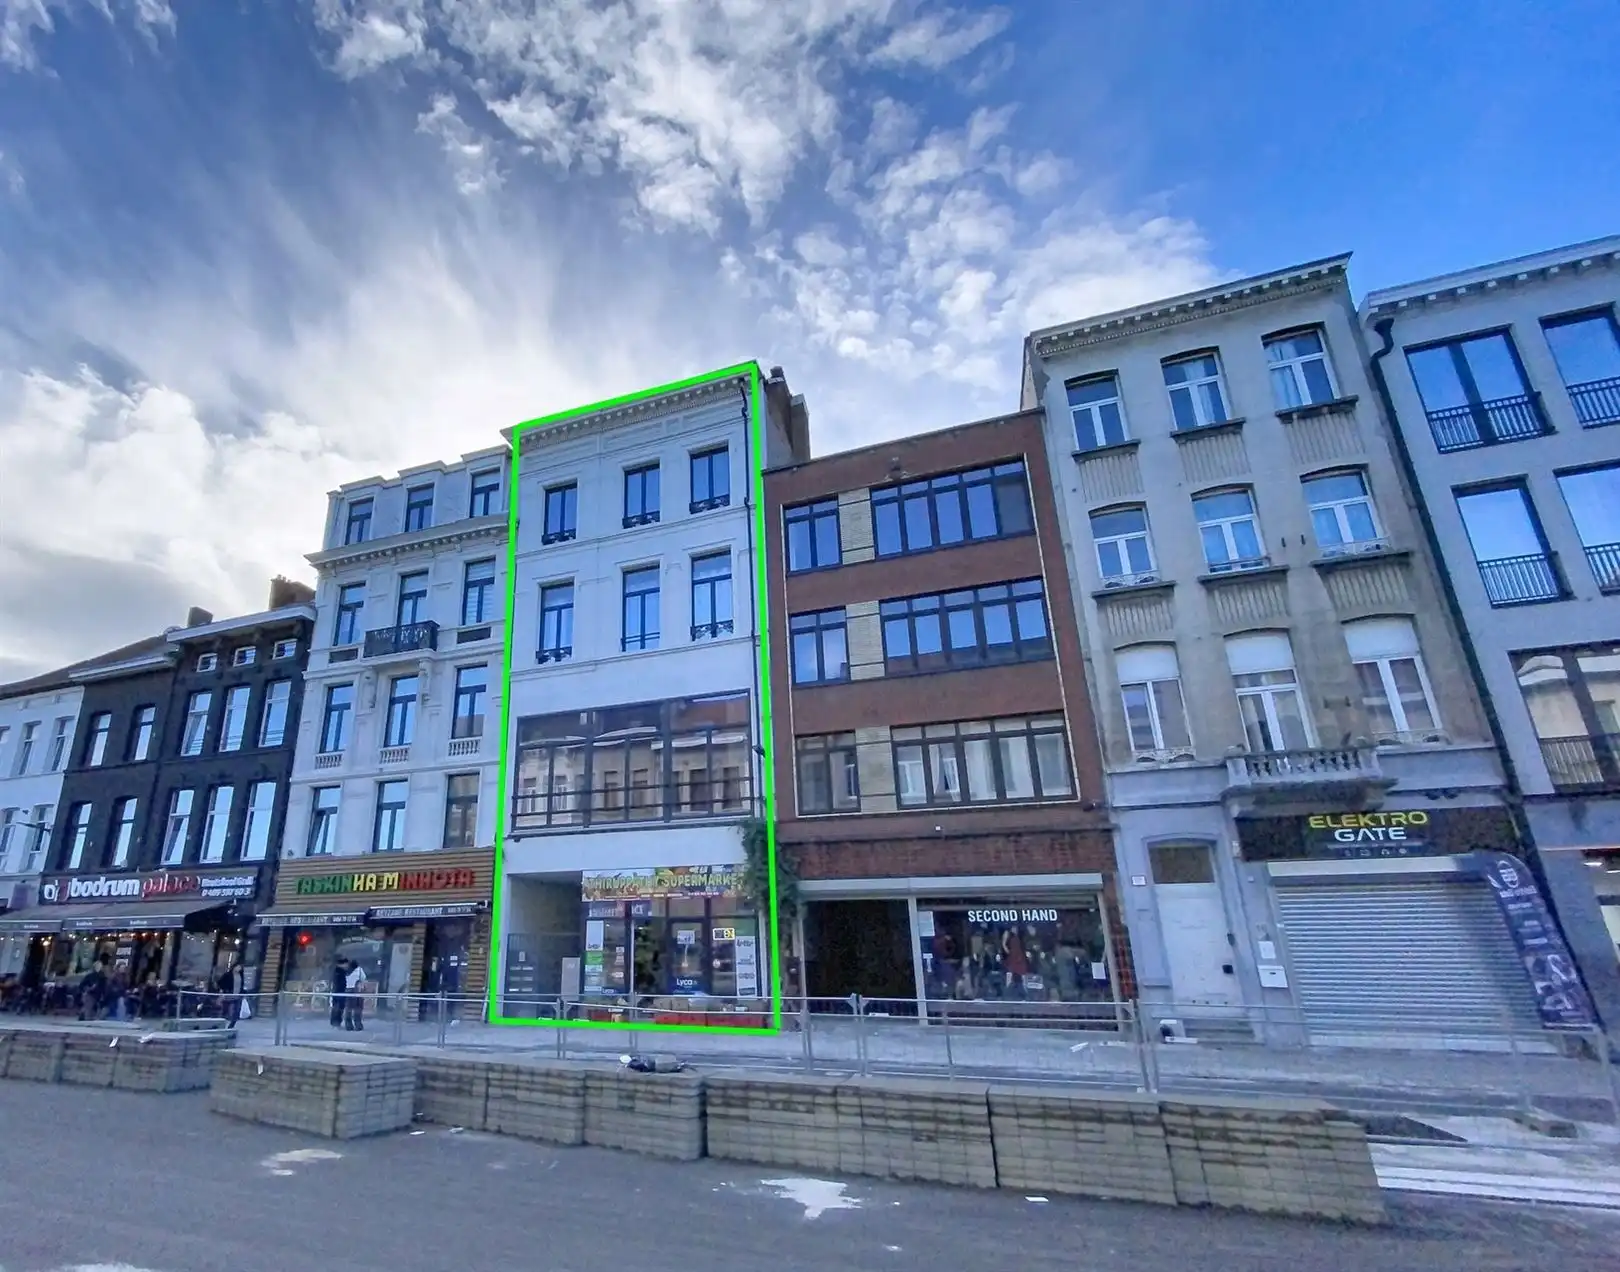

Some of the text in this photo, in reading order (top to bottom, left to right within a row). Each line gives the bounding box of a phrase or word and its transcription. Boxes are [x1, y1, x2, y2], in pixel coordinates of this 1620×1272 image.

[1309, 811, 1428, 828] ELEKTRO
[1334, 827, 1407, 841] GATE
[71, 877, 140, 898] bodrum
[967, 909, 1058, 922] SECOND HAND
[676, 978, 693, 986] Lyca
